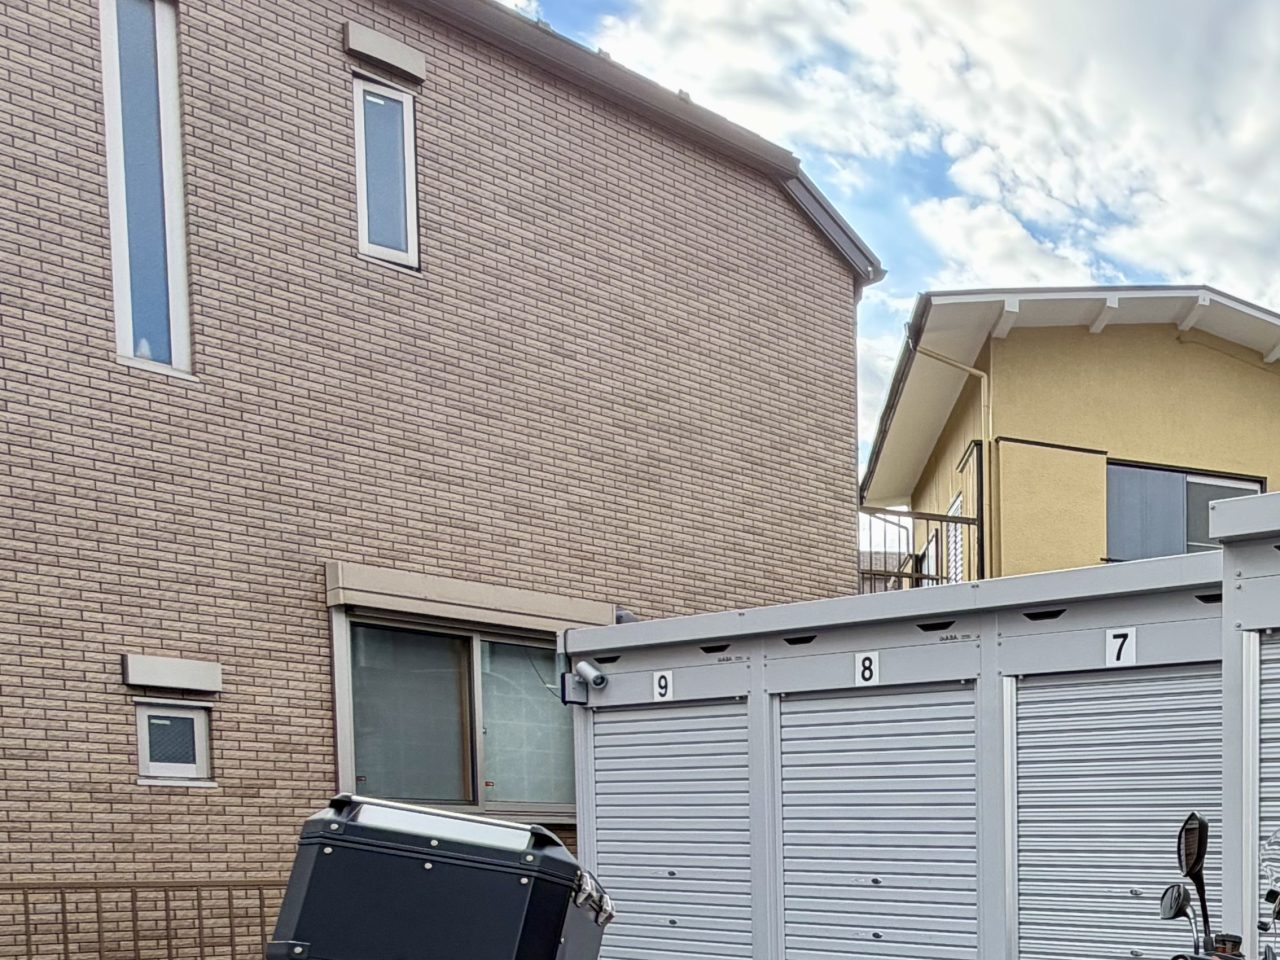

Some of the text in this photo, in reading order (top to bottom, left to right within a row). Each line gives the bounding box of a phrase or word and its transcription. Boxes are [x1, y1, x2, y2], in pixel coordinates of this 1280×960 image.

[1112, 633, 1129, 662] 7
[861, 656, 874, 682] 8
[657, 674, 668, 698] 9
